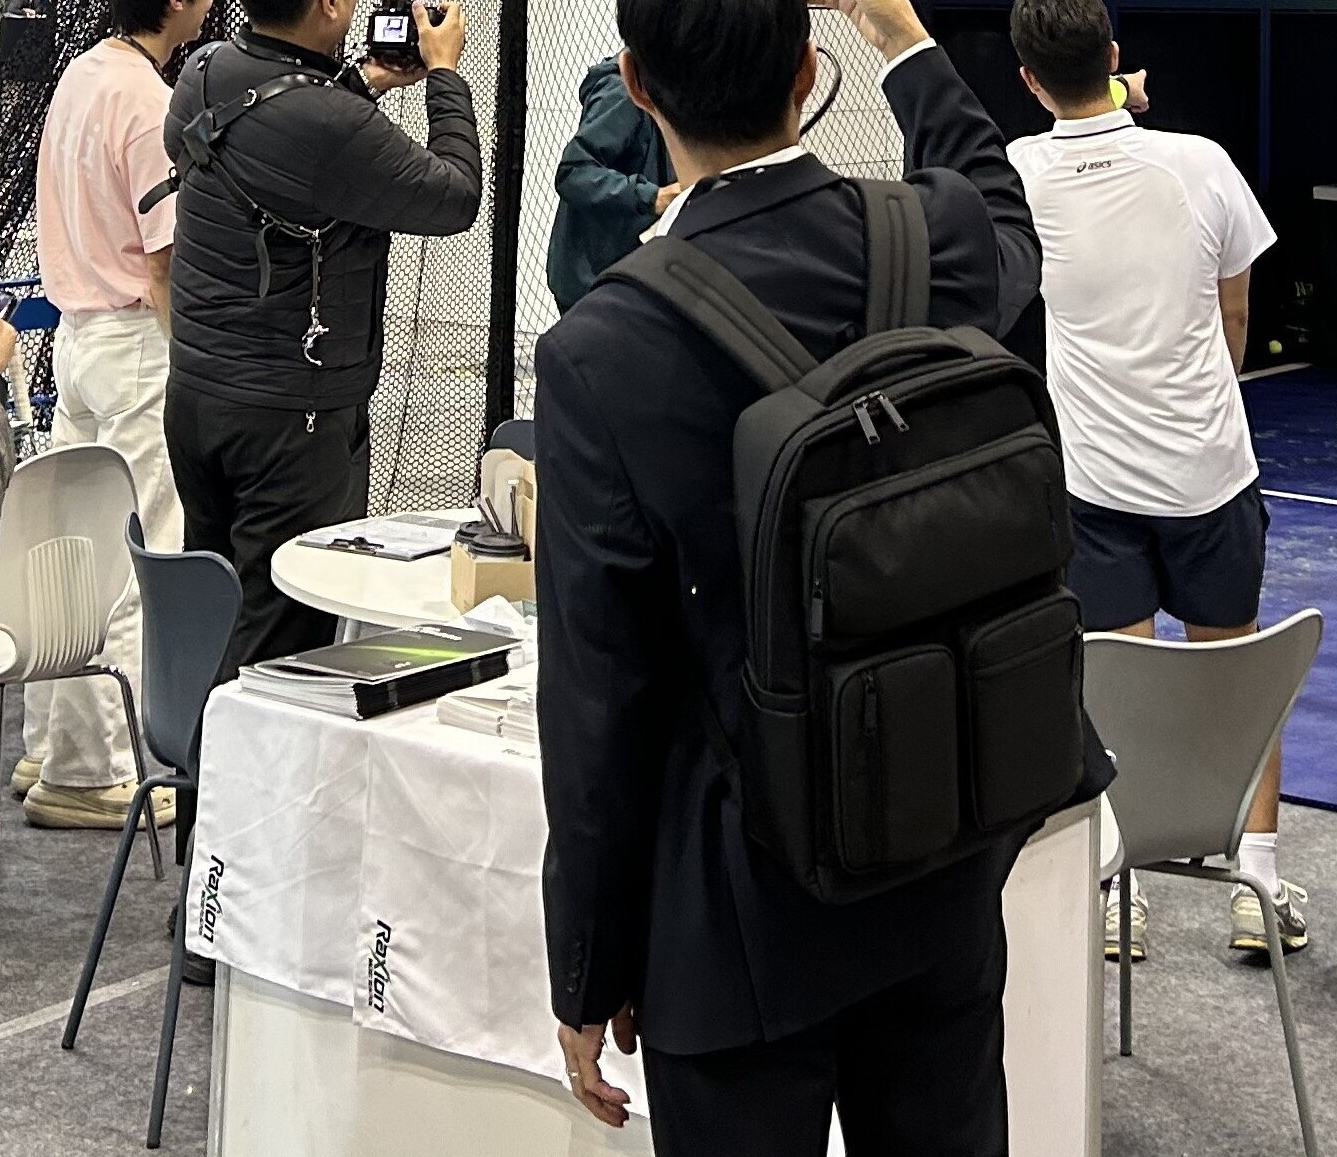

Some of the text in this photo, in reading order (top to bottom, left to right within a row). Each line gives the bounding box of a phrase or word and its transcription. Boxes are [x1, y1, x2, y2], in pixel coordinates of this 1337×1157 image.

[1088, 160, 1112, 170] asics
[202, 854, 225, 943] Raxion
[368, 919, 391, 1013] Raxion
